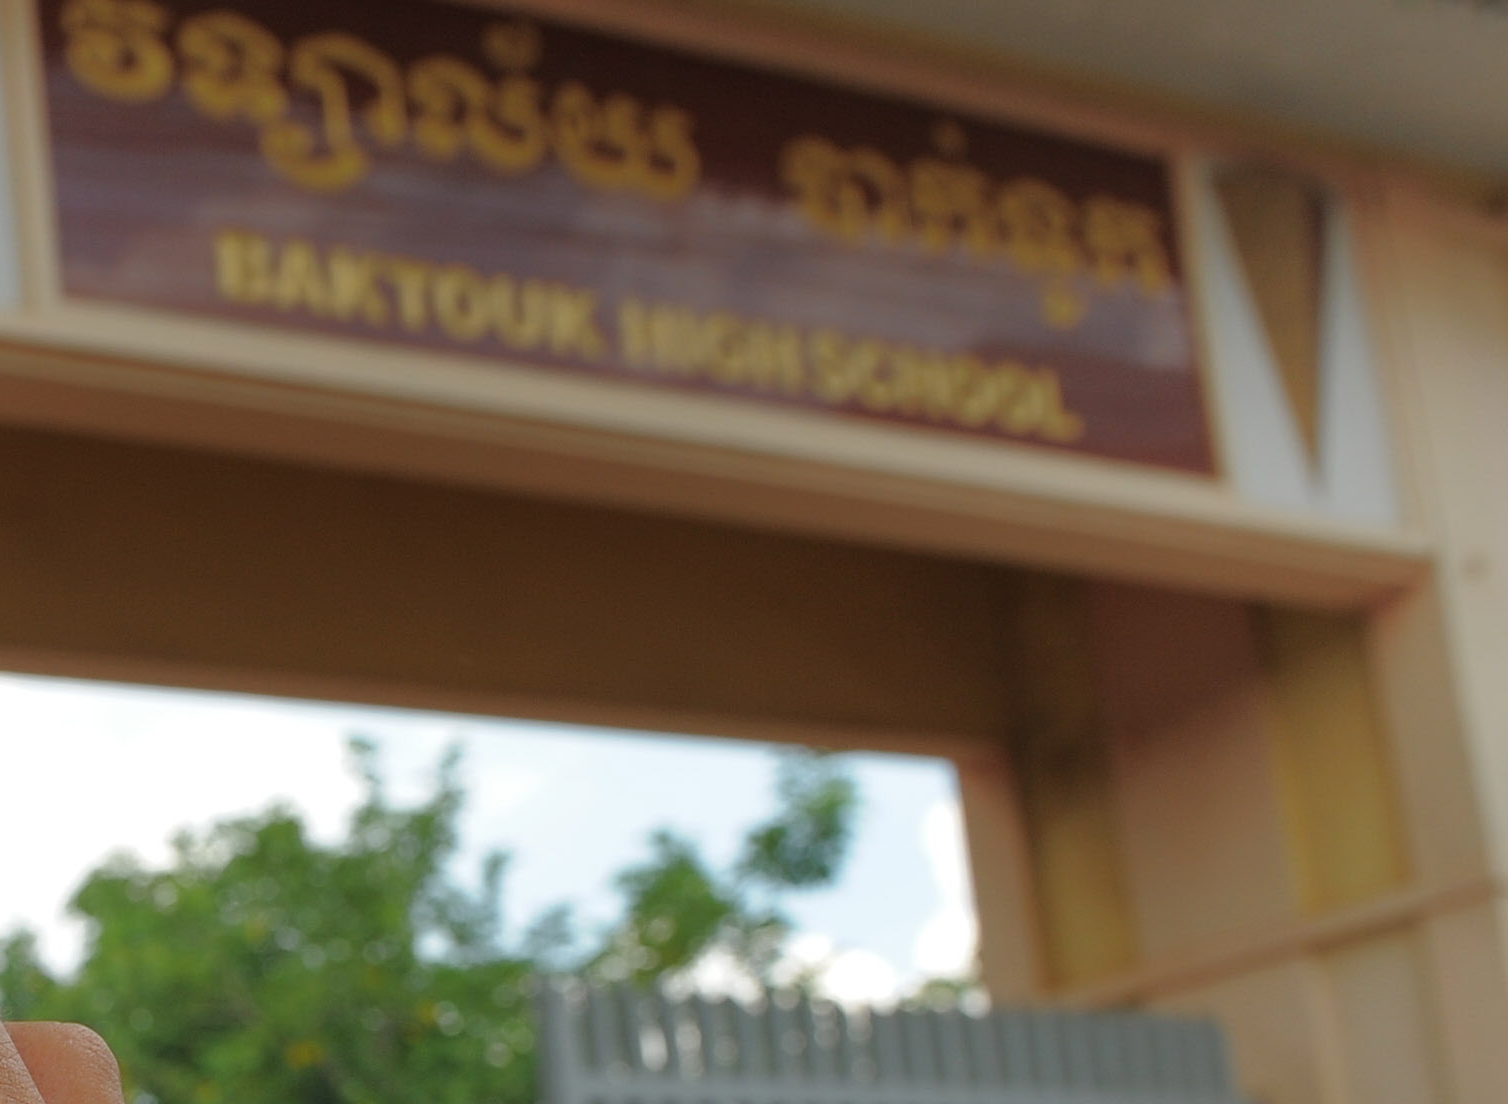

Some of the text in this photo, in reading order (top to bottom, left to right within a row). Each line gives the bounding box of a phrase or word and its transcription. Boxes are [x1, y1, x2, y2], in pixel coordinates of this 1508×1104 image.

[216, 230, 1084, 442] BAKTOUK HIGH SCHOOL
